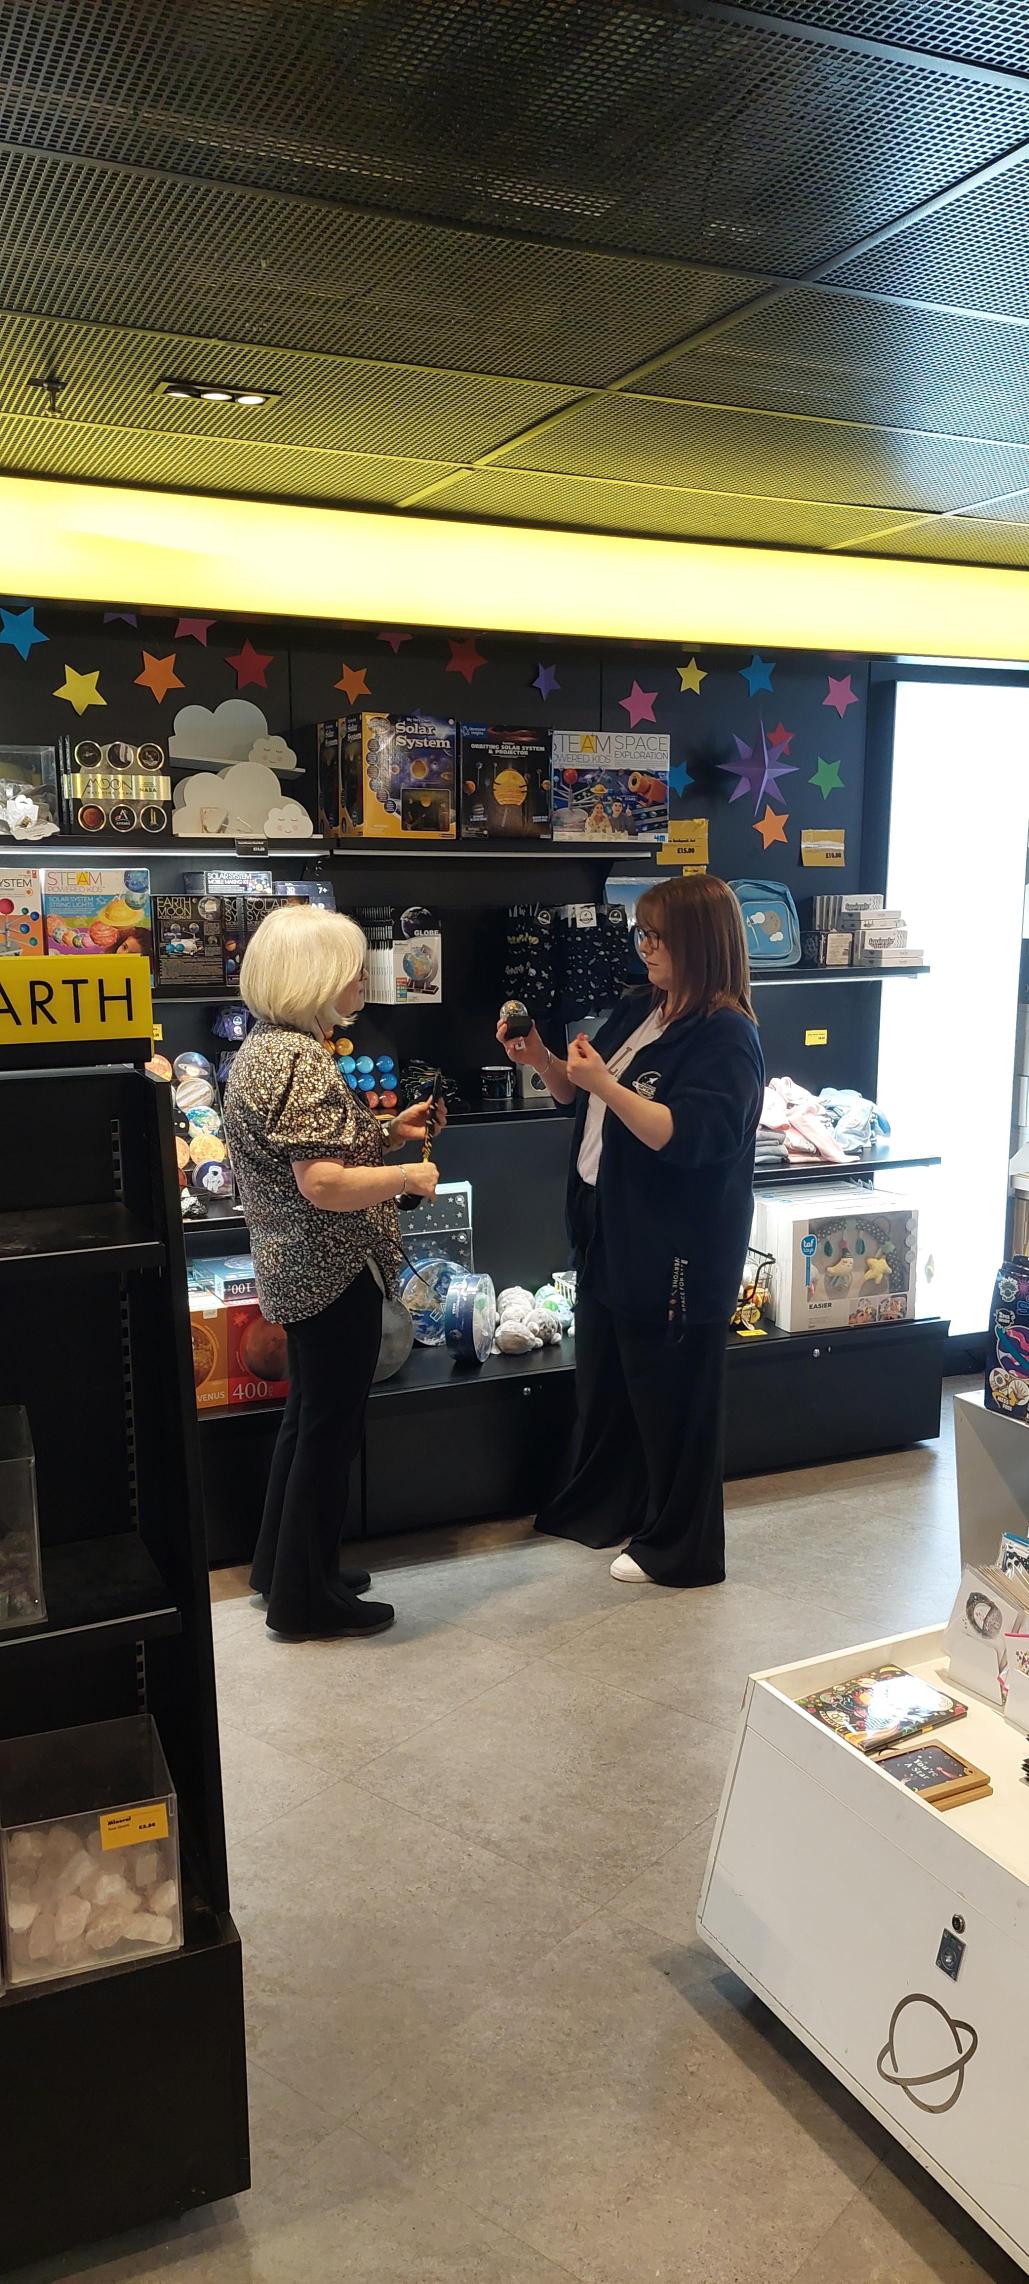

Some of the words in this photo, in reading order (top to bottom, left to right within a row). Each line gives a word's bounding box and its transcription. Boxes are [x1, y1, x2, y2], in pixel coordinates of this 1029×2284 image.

[396, 721, 435, 735] Solar
[396, 736, 451, 750] System
[615, 735, 669, 752] SPACE
[615, 751, 669, 761] EXPLORATION
[47, 871, 103, 886] STEAM
[208, 872, 228, 880] SOLAR
[157, 897, 191, 907] EARTH
[157, 906, 192, 916] MOON
[808, 1302, 832, 1310] EASIER
[197, 1391, 225, 1402] VENUS
[233, 1381, 268, 1400] 400
[911, 1767, 930, 1780] Star
[914, 1759, 939, 1778] You're
